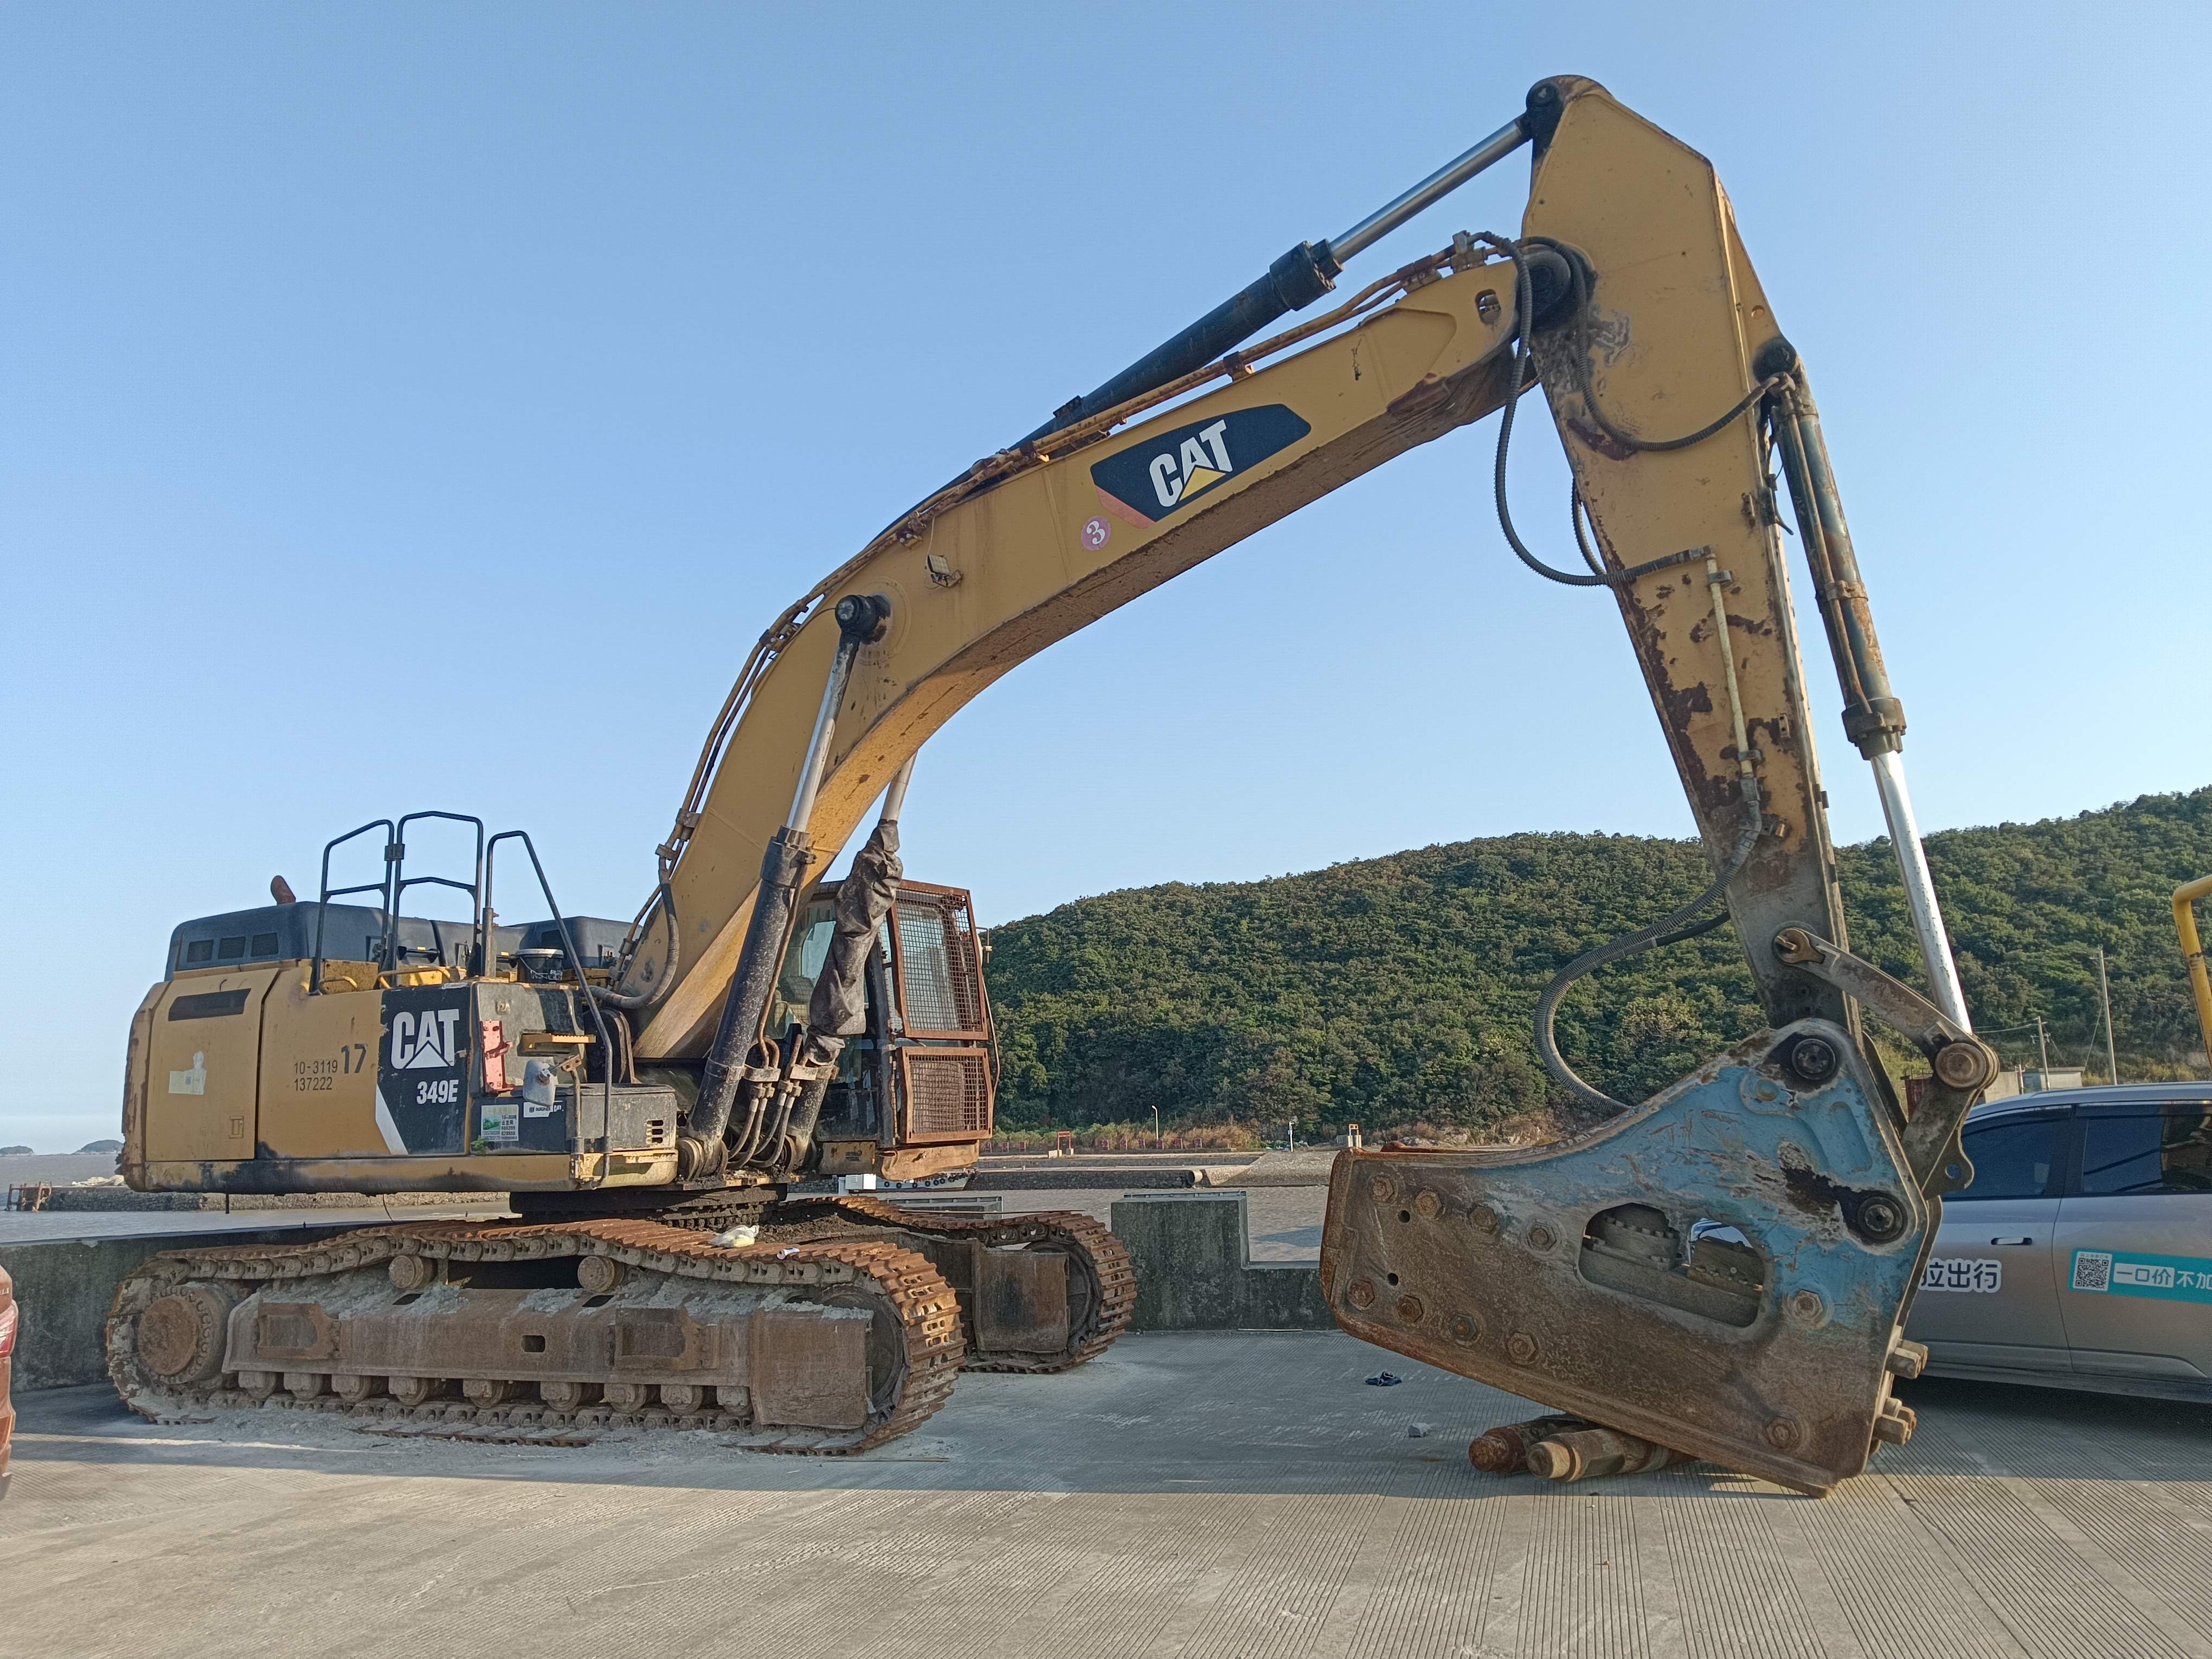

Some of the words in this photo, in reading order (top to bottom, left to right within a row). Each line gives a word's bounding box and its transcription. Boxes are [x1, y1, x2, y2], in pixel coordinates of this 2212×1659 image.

[1149, 419, 1233, 507] CAT
[1086, 520, 1105, 545] 3
[391, 1008, 460, 1069] CAT
[294, 1059, 338, 1075] 10-3119
[341, 1043, 368, 1074] 17
[294, 1076, 332, 1091] 137222
[416, 1079, 459, 1104] 349E
